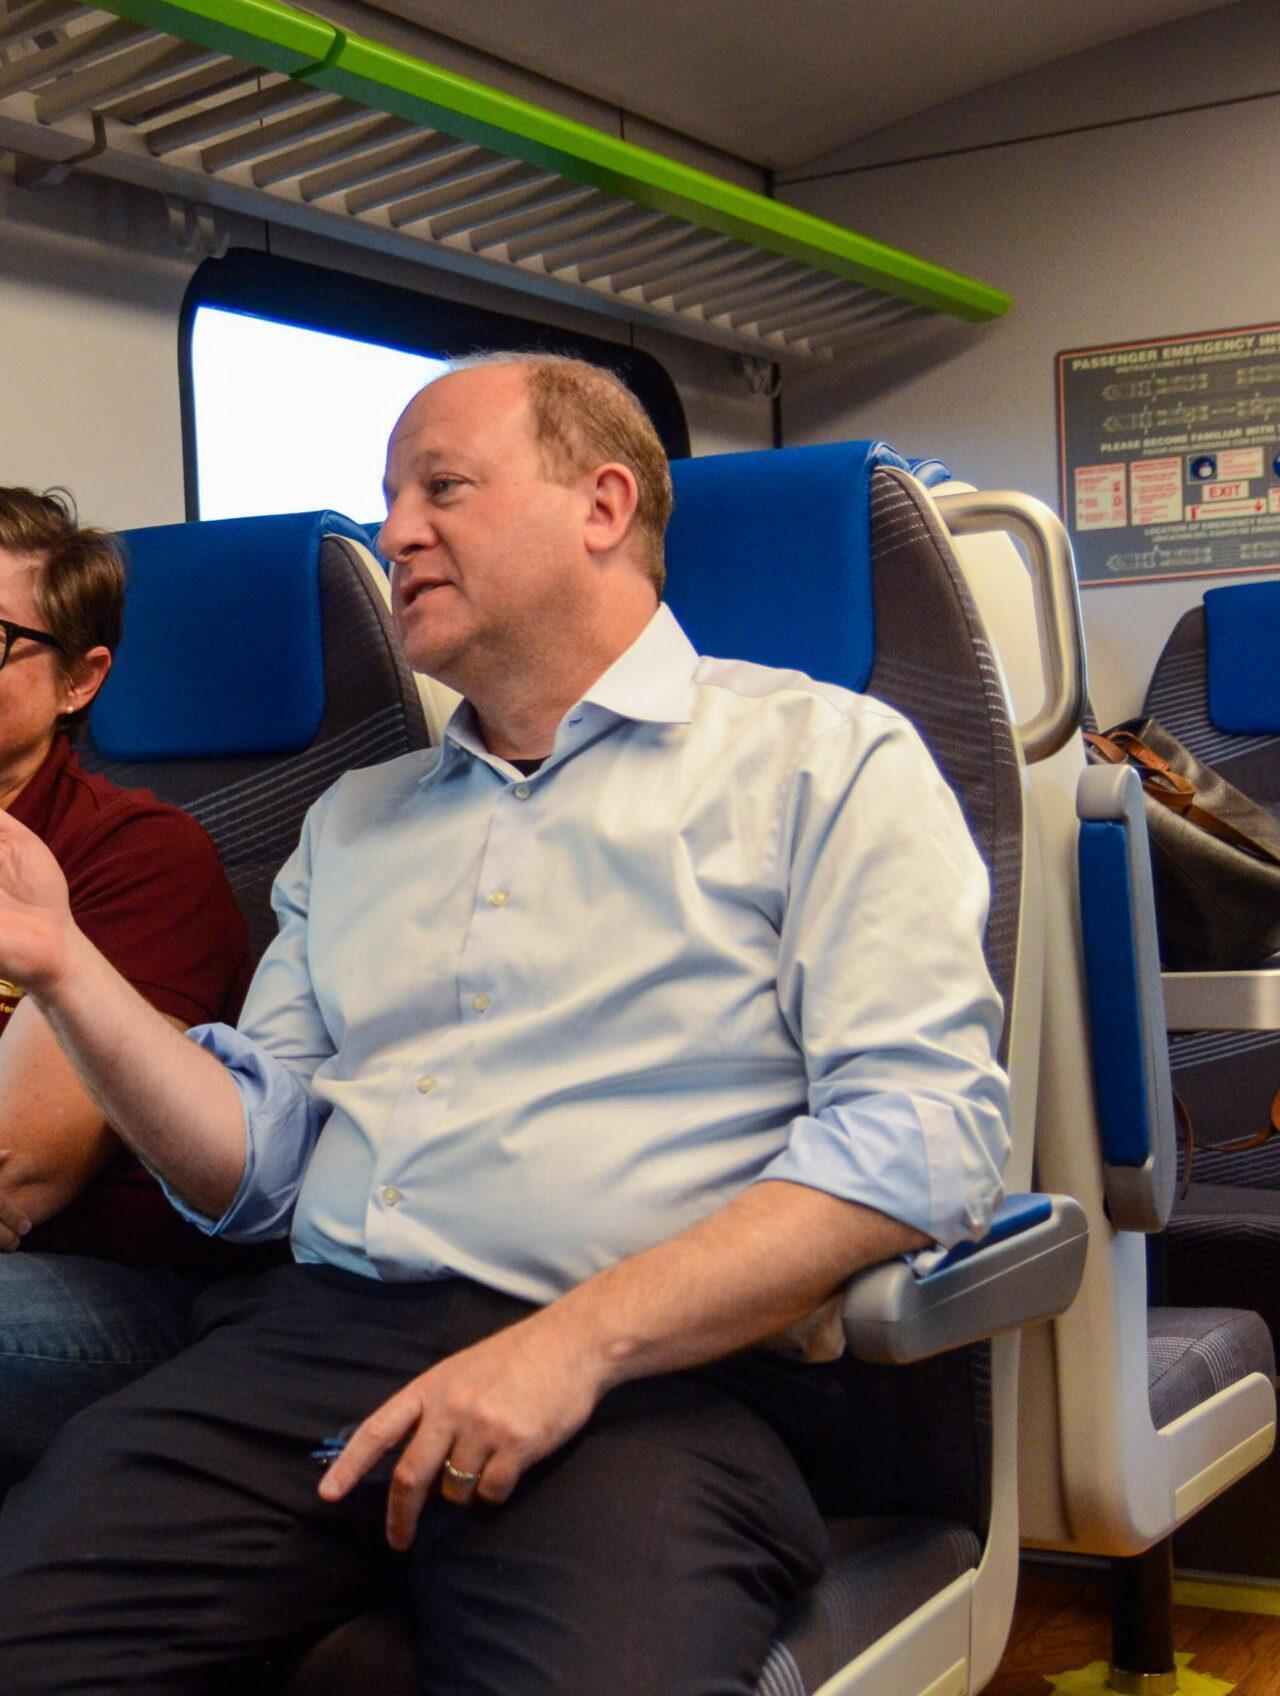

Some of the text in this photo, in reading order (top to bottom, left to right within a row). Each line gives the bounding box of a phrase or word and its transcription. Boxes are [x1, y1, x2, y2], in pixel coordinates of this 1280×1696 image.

[1072, 349, 1158, 371] PASSENGER
[1162, 336, 1255, 359] EMERGENCY
[1209, 484, 1241, 499] EXIT
